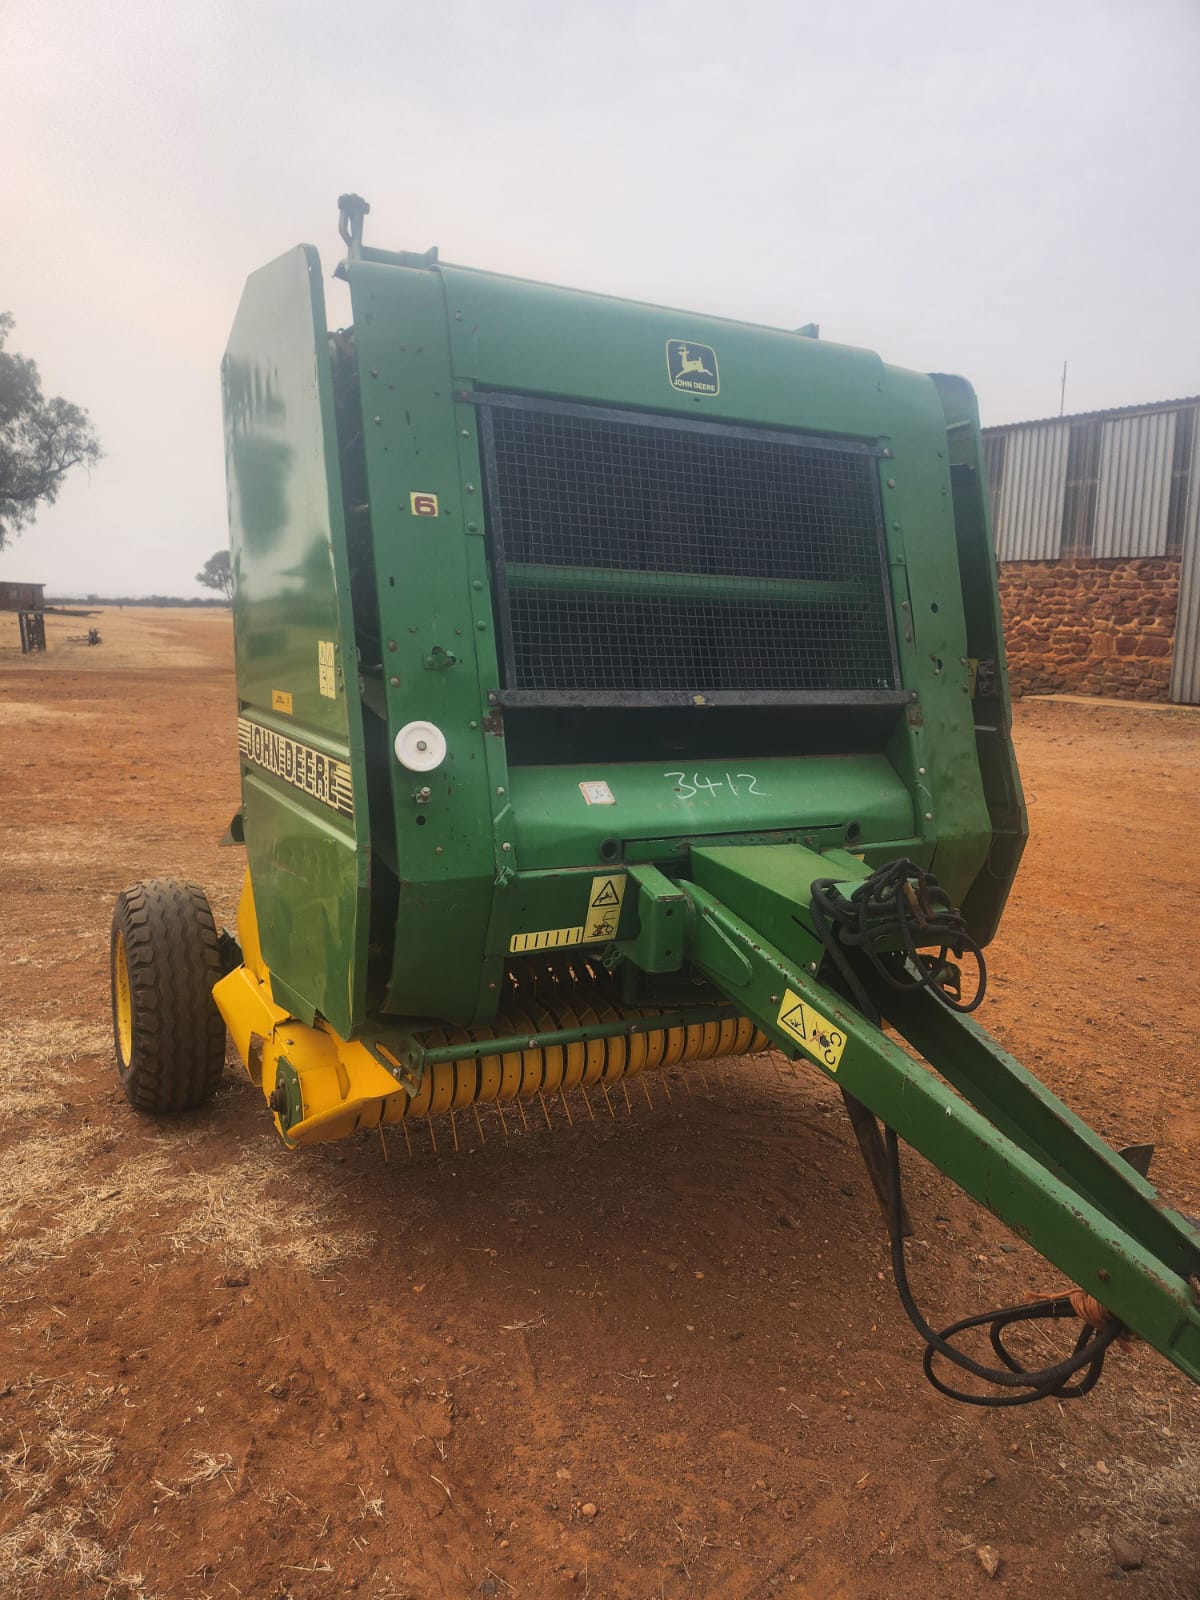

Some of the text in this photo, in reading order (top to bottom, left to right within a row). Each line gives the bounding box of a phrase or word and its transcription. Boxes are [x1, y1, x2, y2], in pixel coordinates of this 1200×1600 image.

[673, 378, 716, 392] JOHN DEERE
[414, 496, 436, 516] 6
[247, 723, 339, 808] JOHN DEERE
[664, 771, 772, 799] 3412
